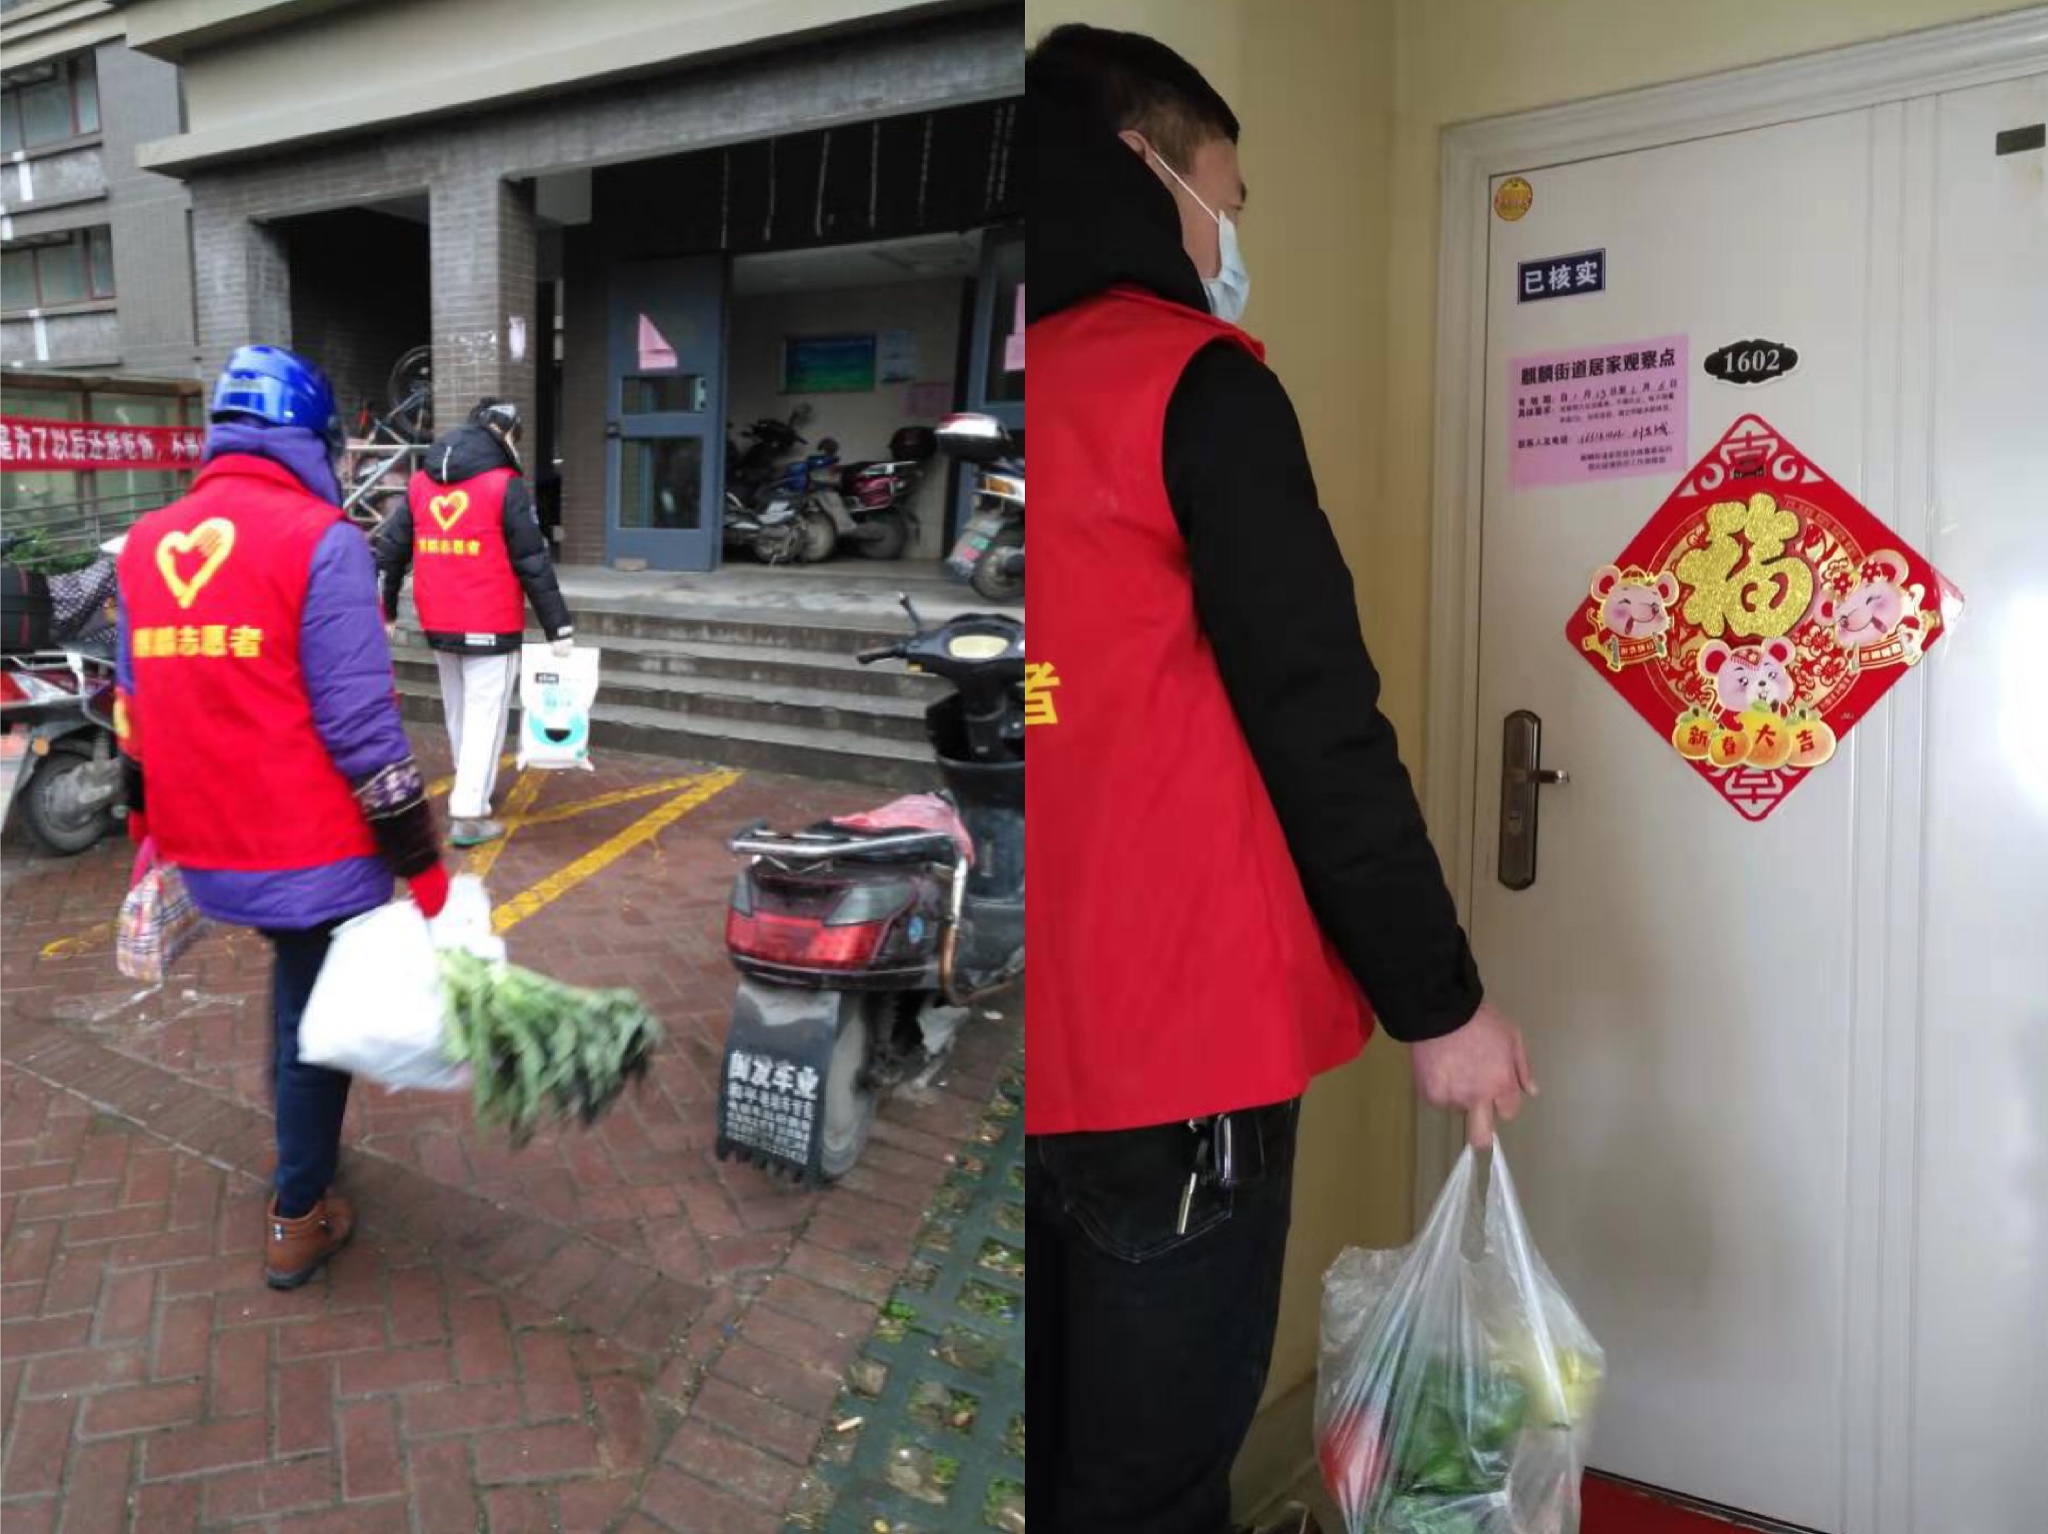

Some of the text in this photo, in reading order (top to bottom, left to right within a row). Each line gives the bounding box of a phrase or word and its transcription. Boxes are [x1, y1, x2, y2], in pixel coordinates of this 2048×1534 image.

[1524, 260, 1598, 295] 已核实
[1521, 347, 1676, 386] 麒麟街道居家观察点
[1723, 349, 1780, 373] 1602
[1676, 492, 1814, 638] 福
[1025, 661, 1061, 726] 者
[1687, 723, 1816, 756] 新春大吉
